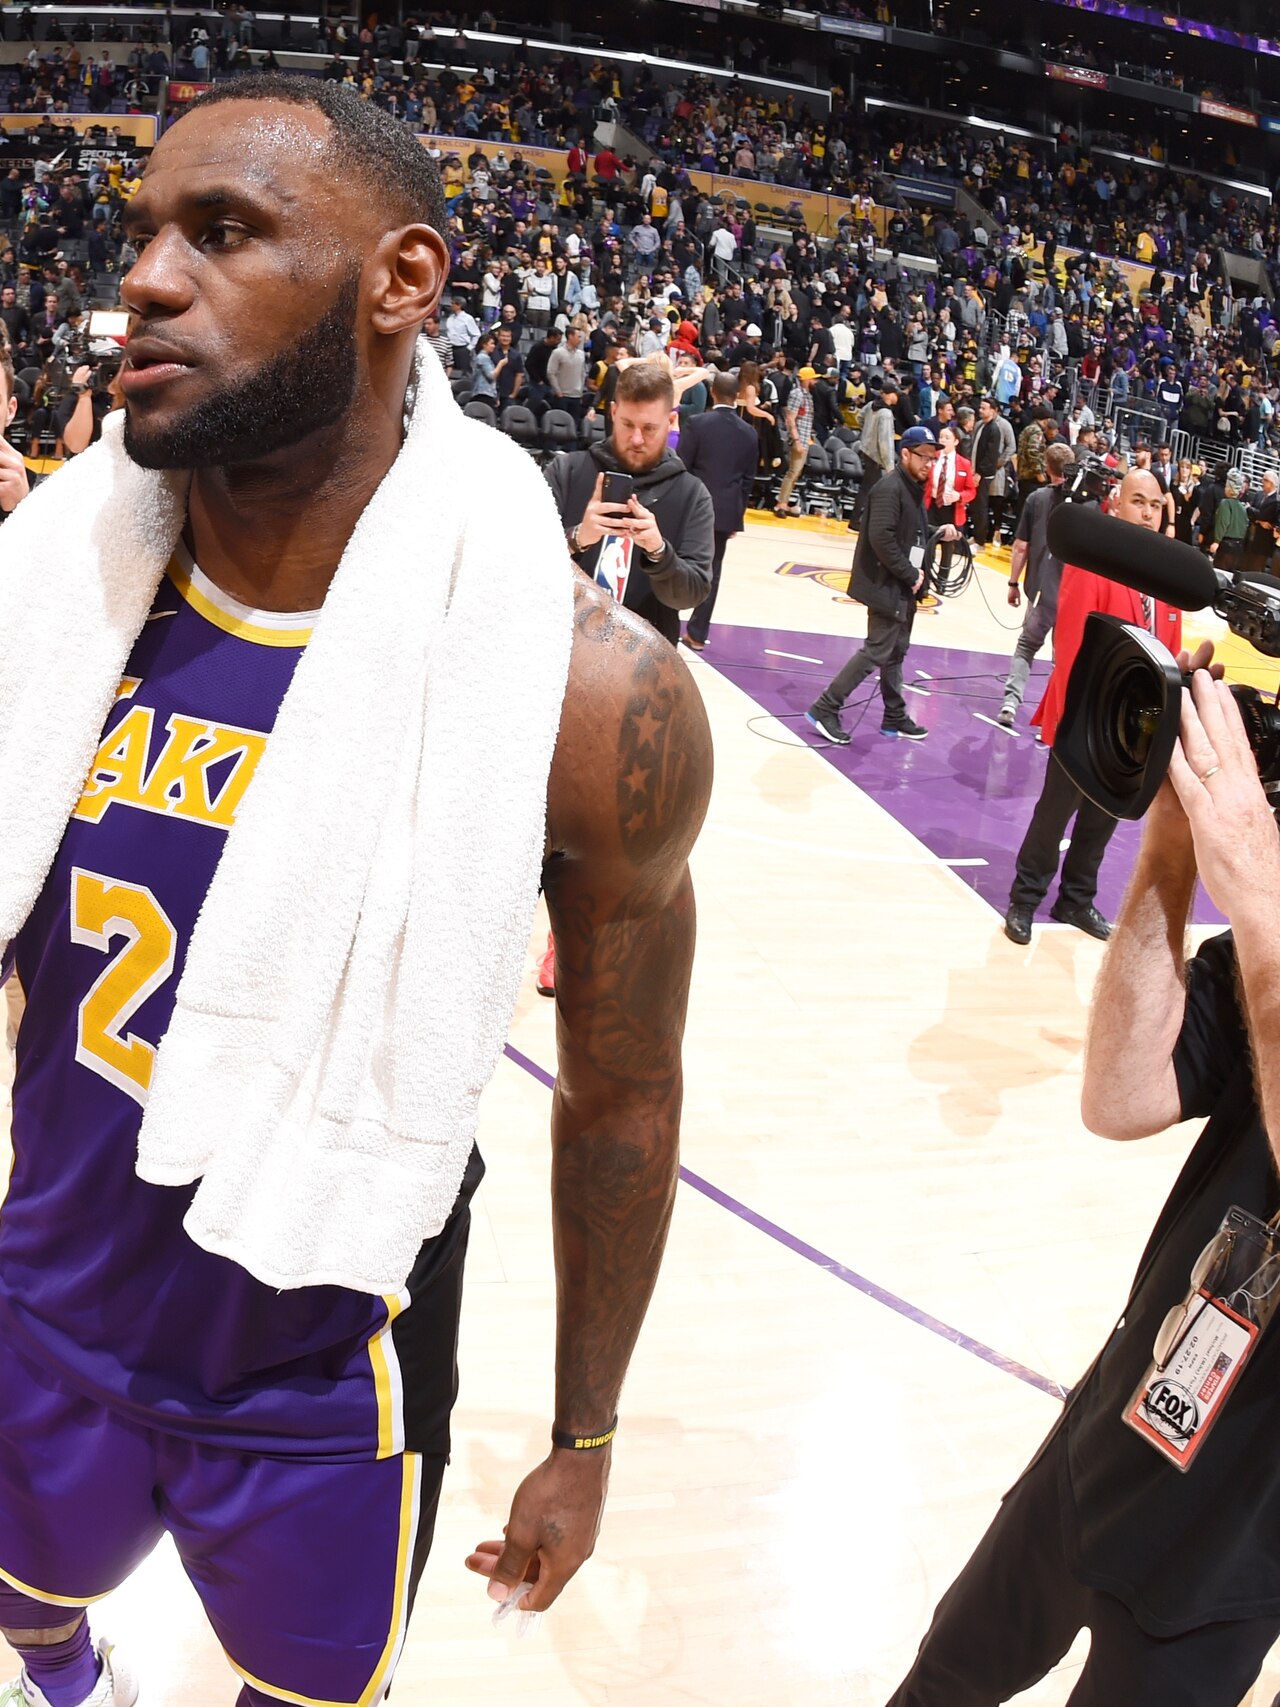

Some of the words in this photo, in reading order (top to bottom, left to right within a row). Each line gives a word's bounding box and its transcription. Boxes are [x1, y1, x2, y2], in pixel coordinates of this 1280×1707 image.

[1201, 101, 1258, 126] TOSHIBA
[1174, 1335, 1199, 1375] 02-27-19
[1199, 1371, 1217, 1397] Center
[1204, 1374, 1221, 1401] STAPLES
[1155, 1386, 1193, 1426] FOX
